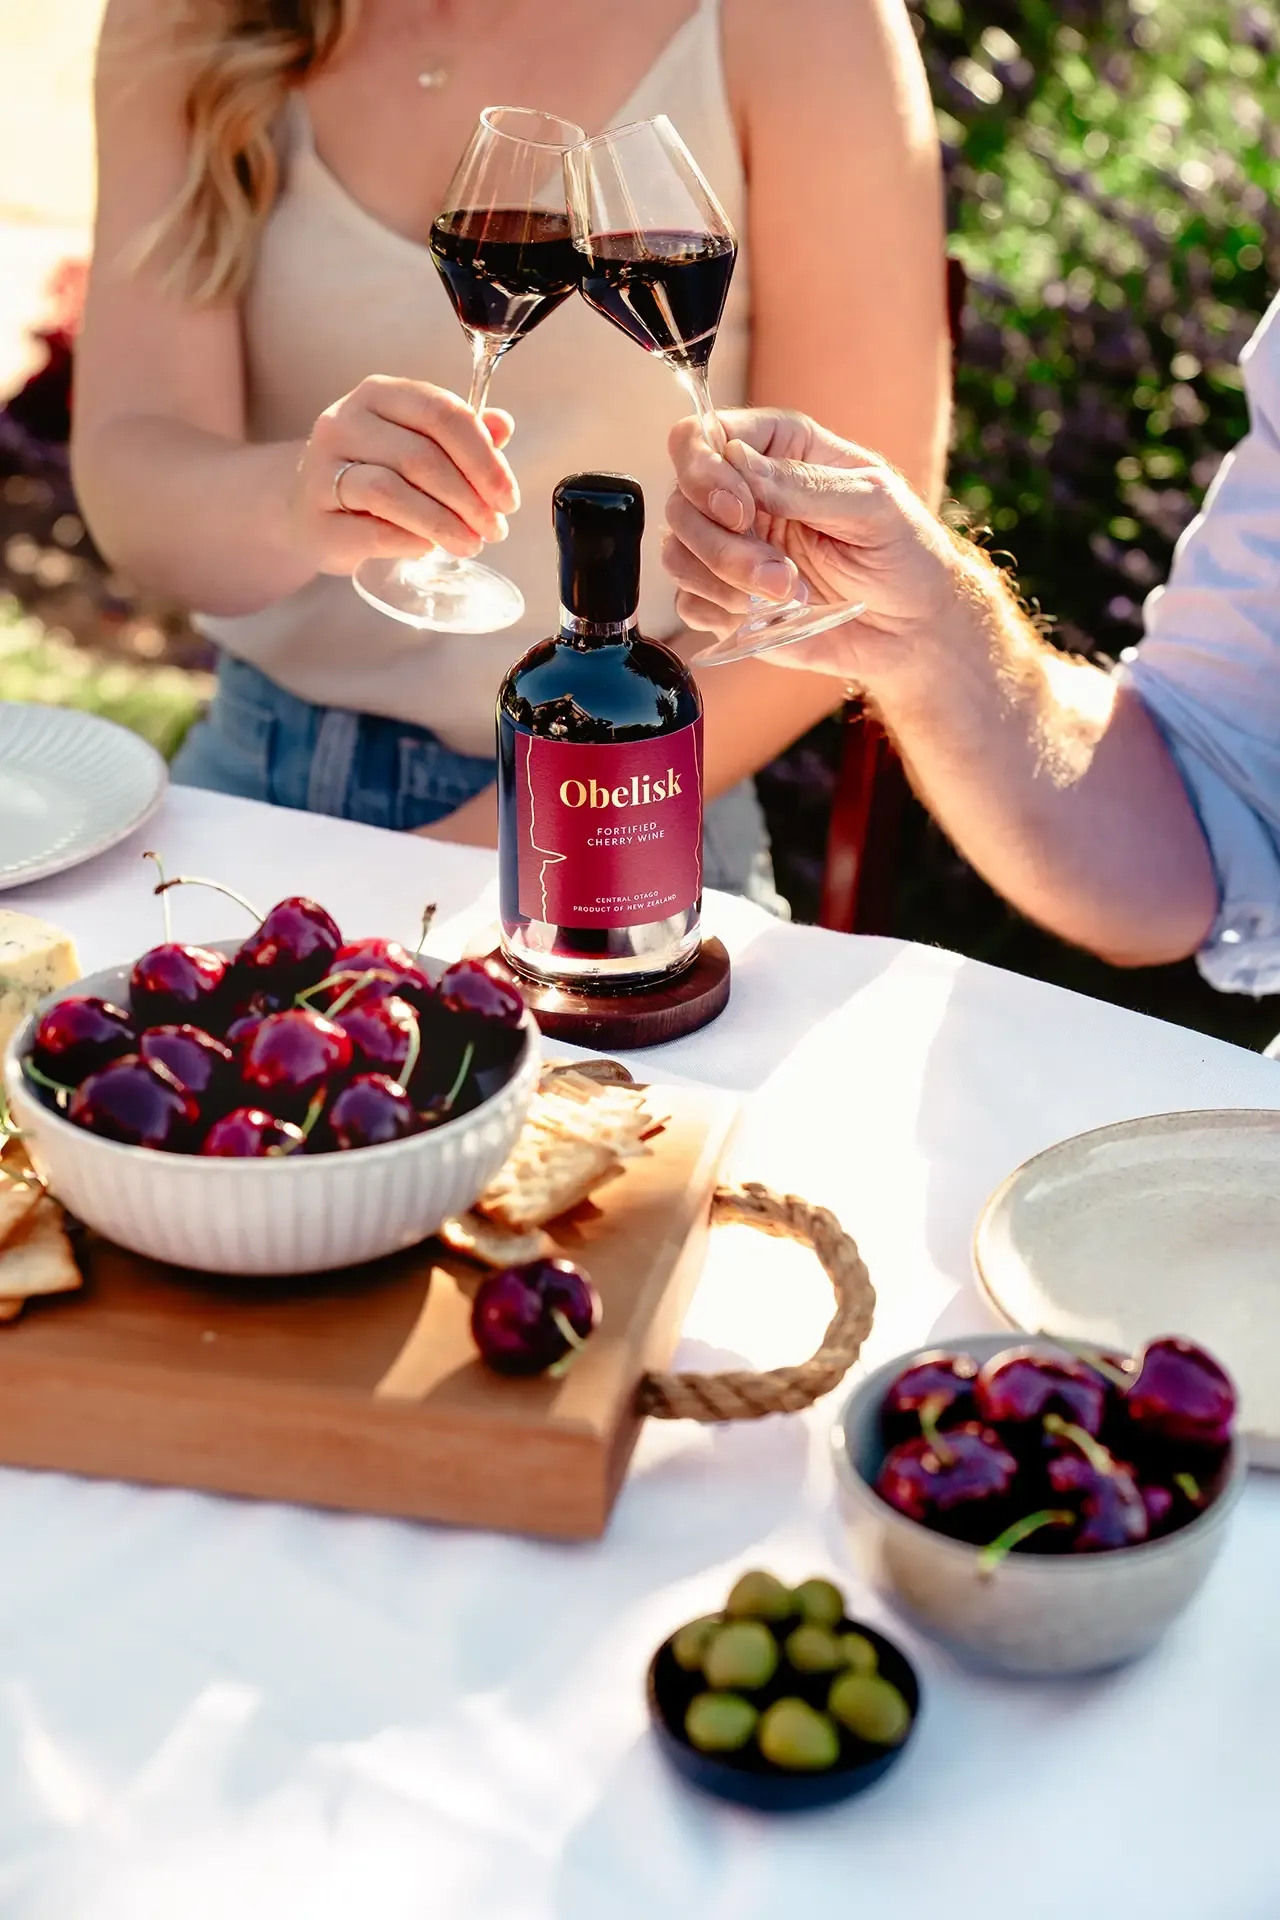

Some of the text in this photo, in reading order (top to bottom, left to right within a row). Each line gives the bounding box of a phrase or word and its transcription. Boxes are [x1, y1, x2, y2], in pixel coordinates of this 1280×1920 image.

[560, 768, 682, 809] Obelisk
[597, 822, 657, 836] FORTIFIED
[587, 830, 665, 847] CHERRY WINE
[595, 890, 659, 904] CENTRAL OTAGO
[647, 893, 677, 908] ZEALAND
